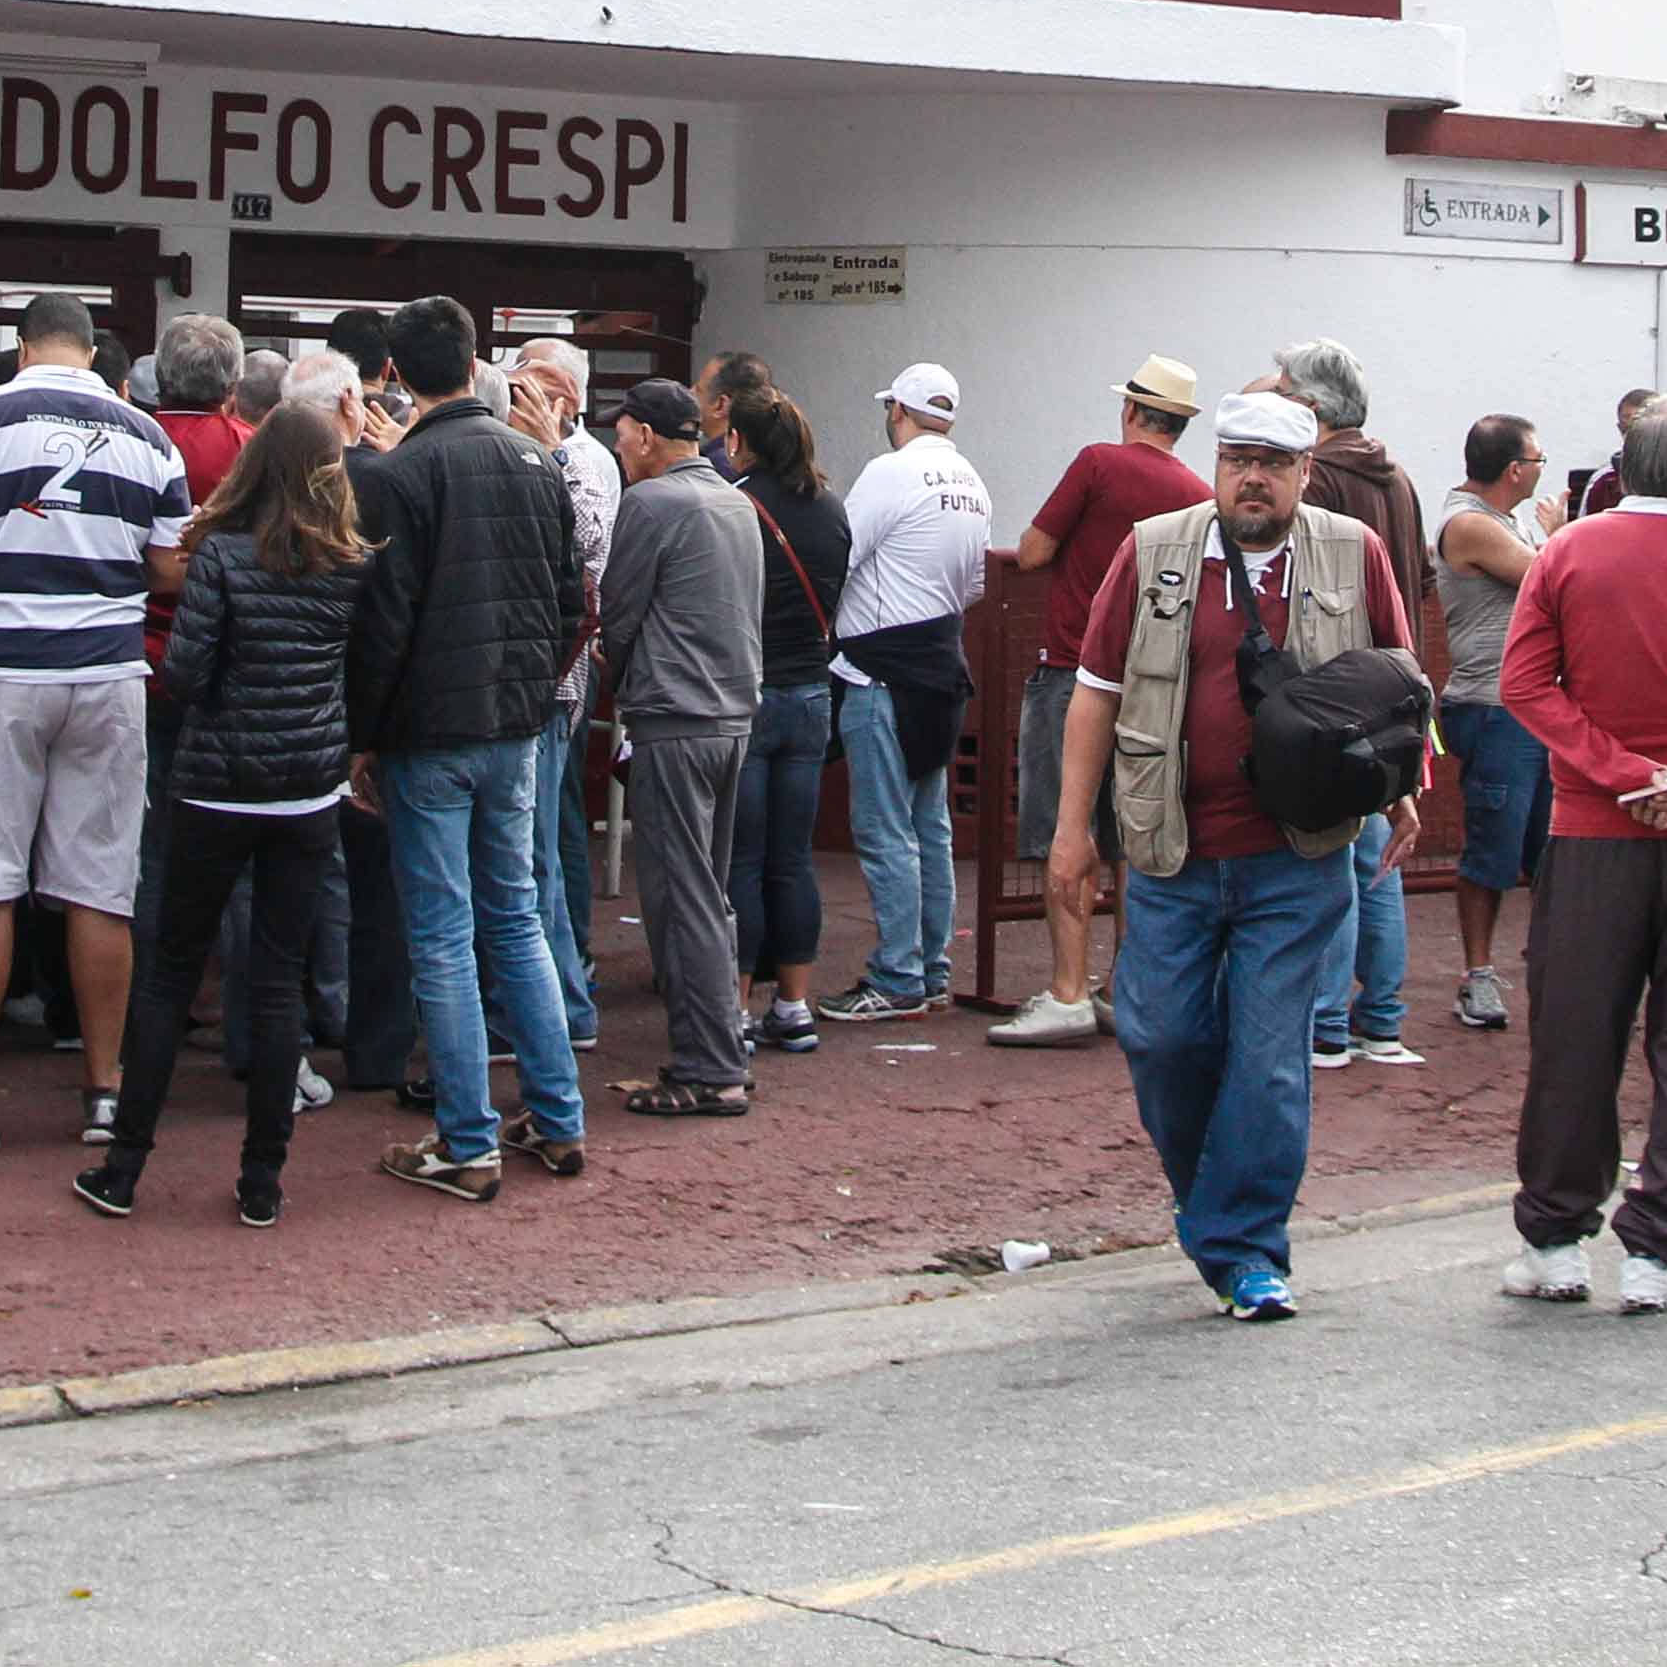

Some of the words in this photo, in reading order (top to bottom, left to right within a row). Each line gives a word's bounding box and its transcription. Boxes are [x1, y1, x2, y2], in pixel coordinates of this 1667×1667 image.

[368, 103, 689, 223] CRESPI
[1446, 199, 1531, 223] ENTRADA
[833, 255, 899, 269] Entrada
[793, 289, 815, 301] 185
[38, 431, 87, 504] 2
[940, 493, 986, 517] FUTSAL
